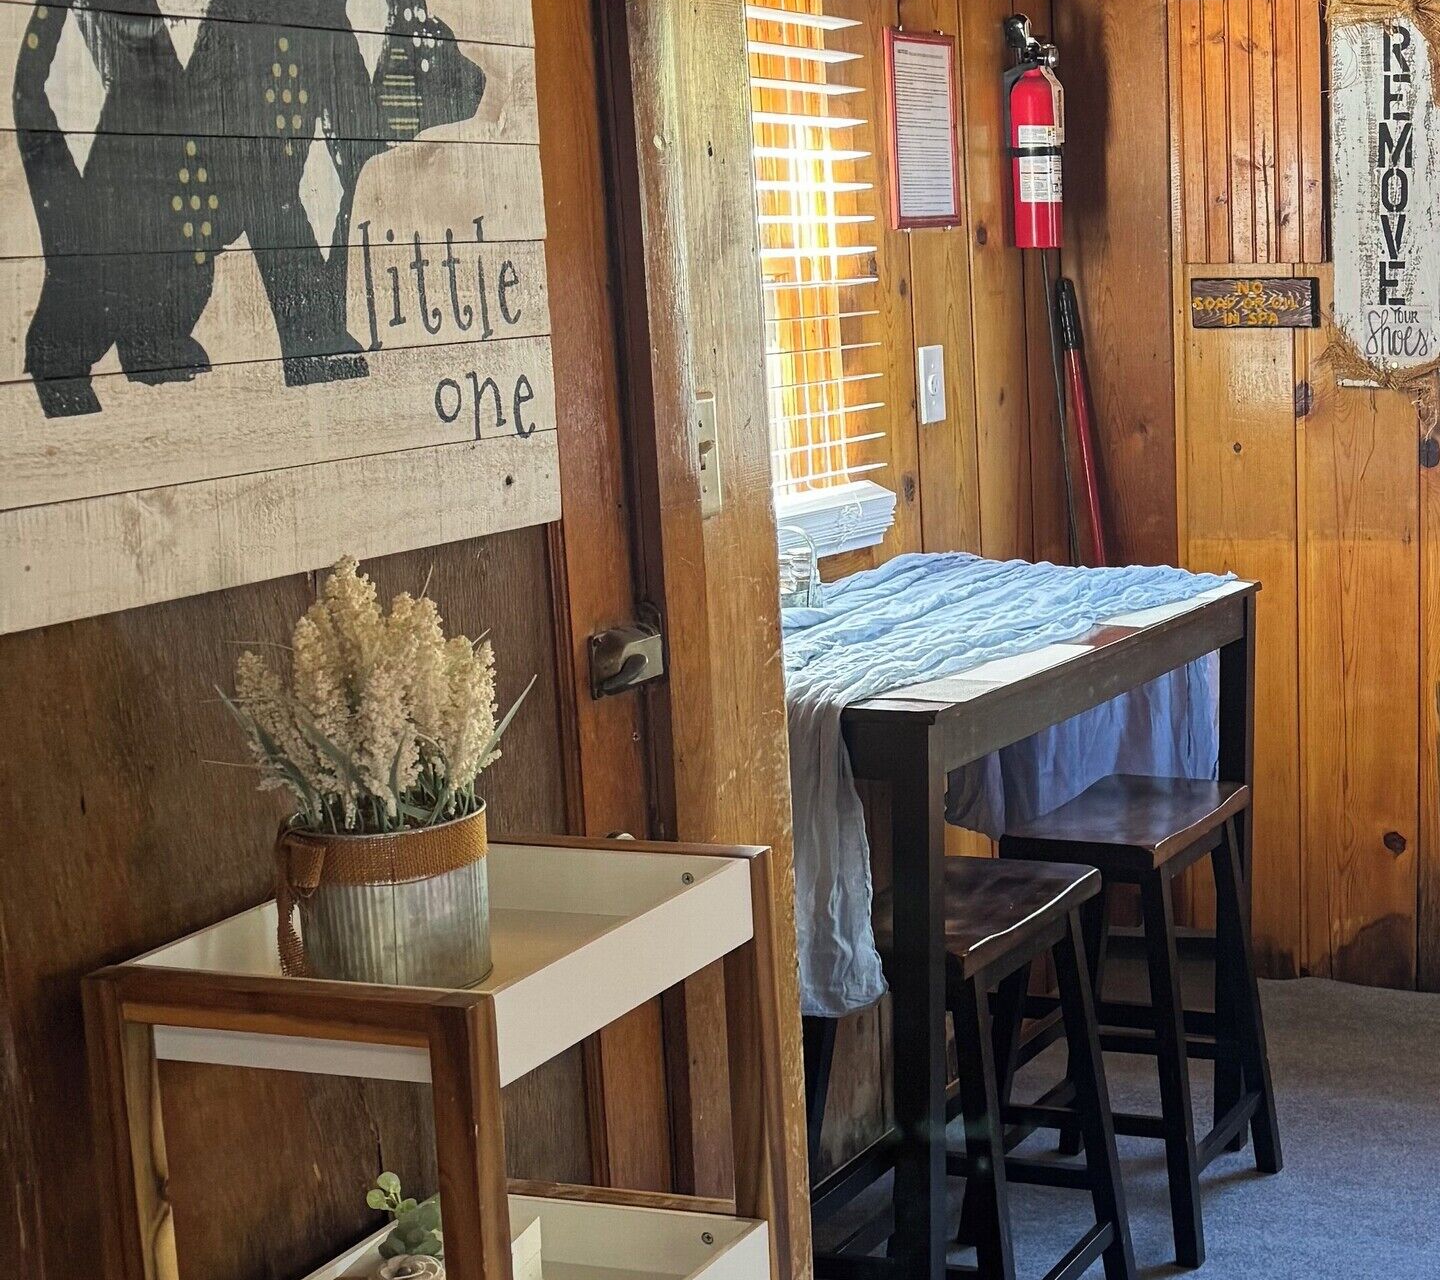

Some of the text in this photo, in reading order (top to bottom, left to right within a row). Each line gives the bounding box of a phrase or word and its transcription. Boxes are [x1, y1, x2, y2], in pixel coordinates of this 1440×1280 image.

[1378, 23, 1413, 306] REMOVE
[358, 216, 522, 351] little
[1236, 280, 1263, 295] NO
[1193, 296, 1299, 311] SOAP OR OIL
[1224, 310, 1279, 326] IN SPA
[1390, 307, 1420, 324] YOUR
[1366, 309, 1429, 357] Shoes
[435, 371, 536, 439] one
